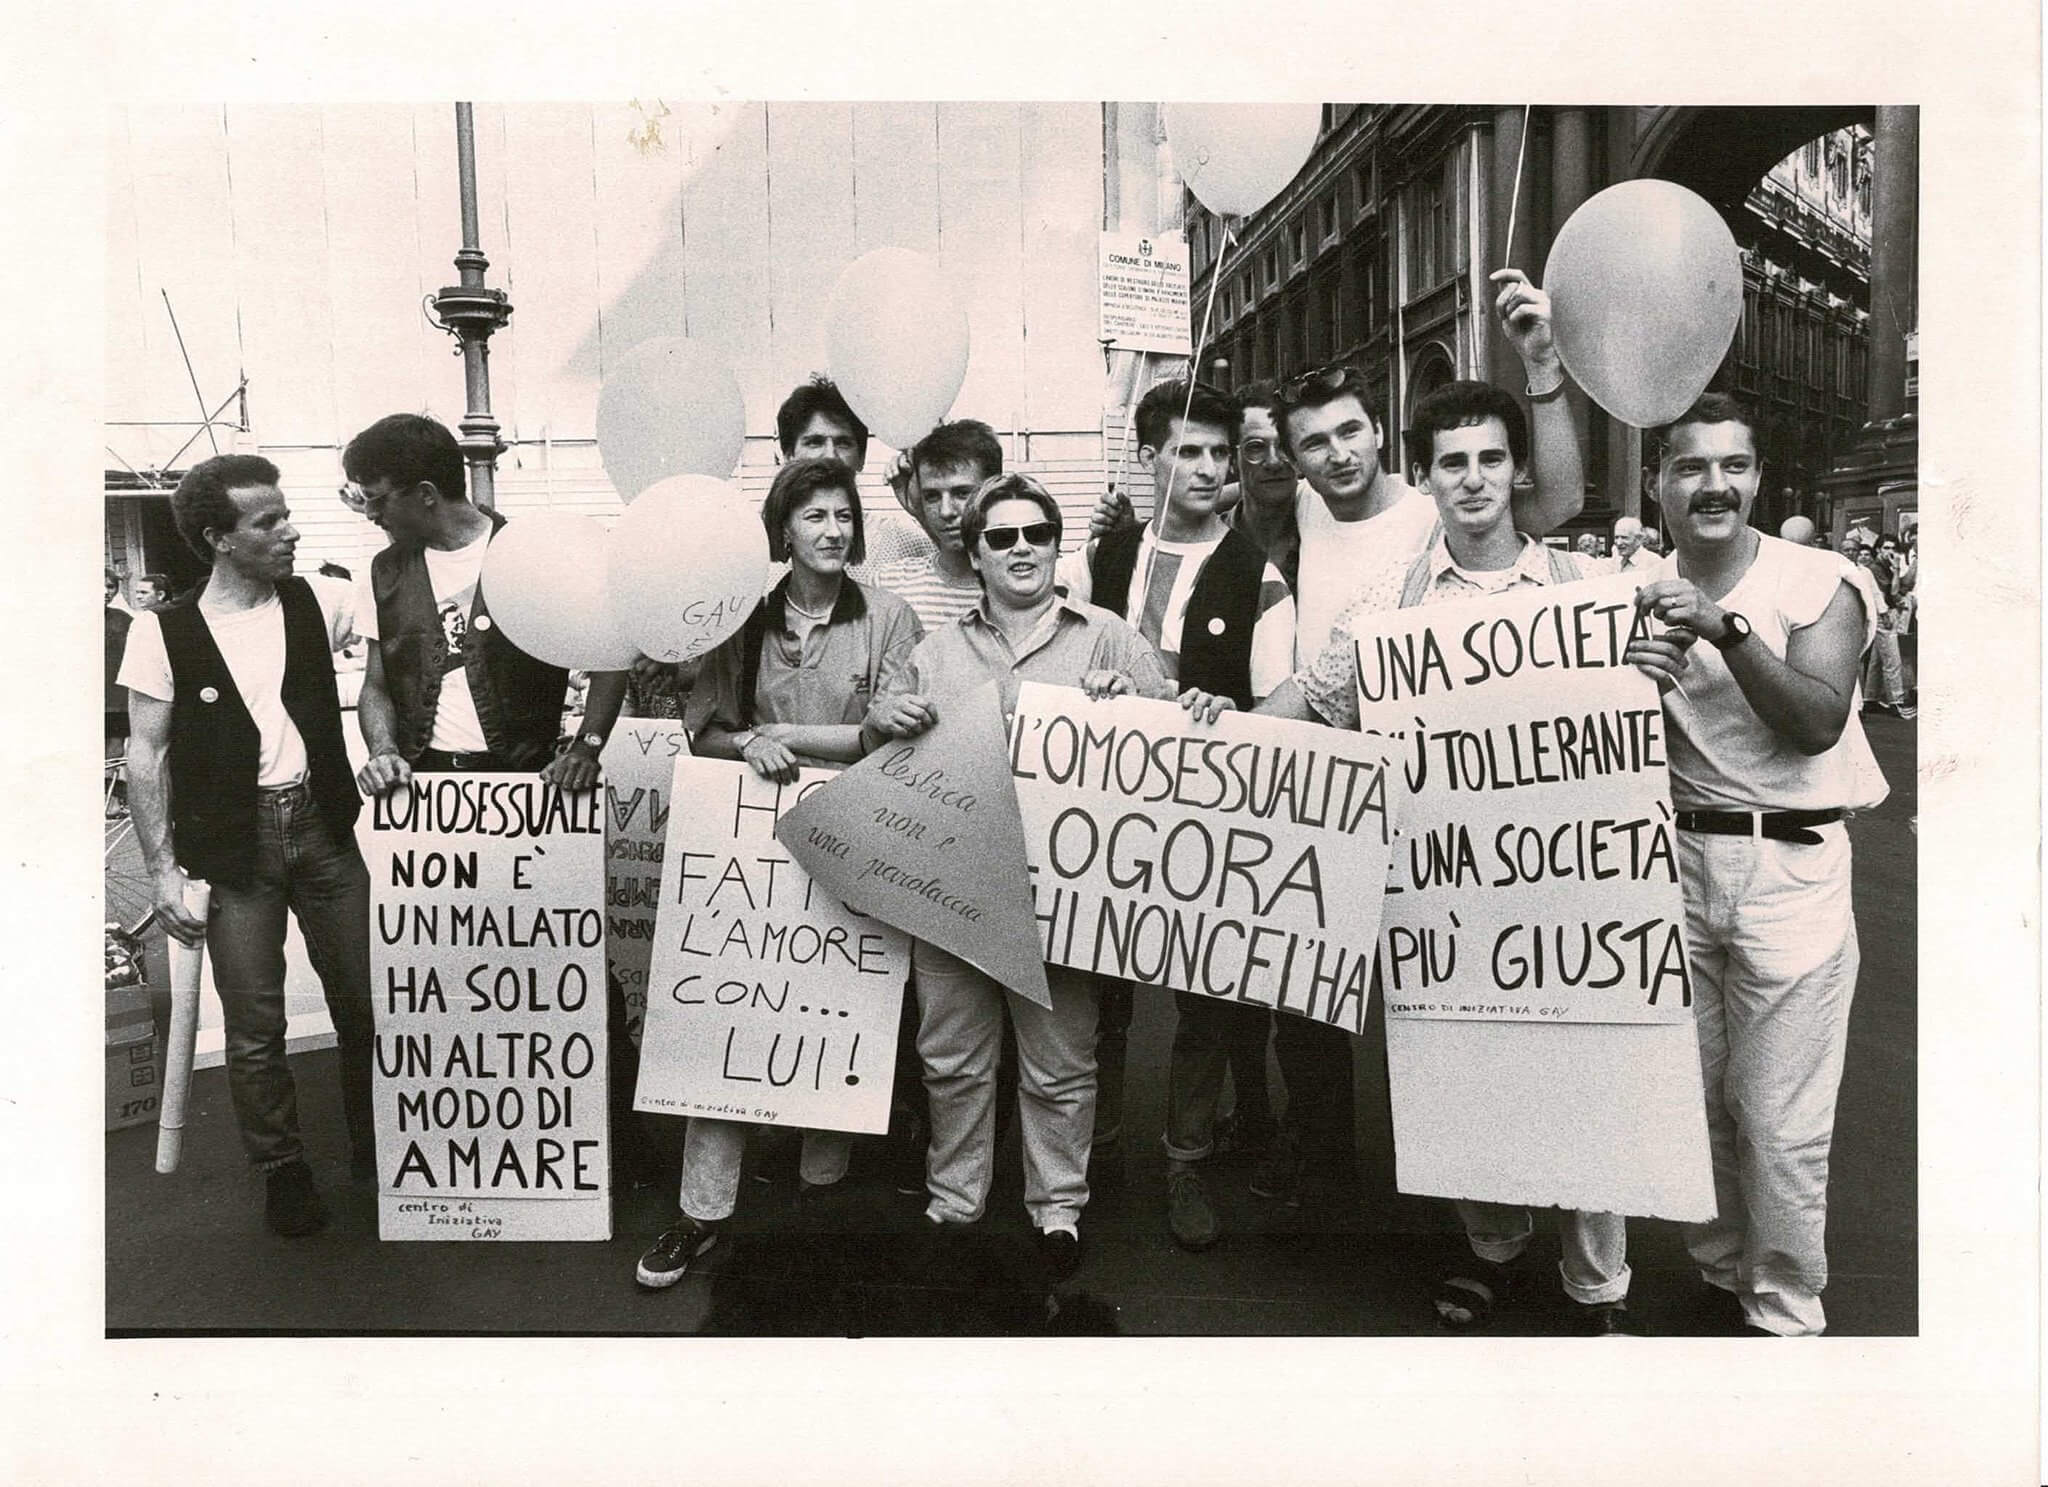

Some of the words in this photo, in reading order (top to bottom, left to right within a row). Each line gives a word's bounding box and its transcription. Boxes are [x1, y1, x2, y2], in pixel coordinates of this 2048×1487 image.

[1108, 254, 1140, 266] COMUNE
[1144, 259, 1151, 267] DI
[1355, 627, 1453, 702] UNA
[1430, 709, 1666, 791] TOLLERANTE
[880, 746, 978, 813] lesbica
[1011, 714, 1391, 845] L'OMOSESSUALITÀ
[873, 806, 928, 841] non
[1411, 822, 1482, 890] UNA
[1493, 801, 1679, 888] SOCIETÀ
[391, 850, 478, 888] NON
[807, 826, 850, 860] una
[856, 856, 985, 923] parolaccia
[1028, 807, 1327, 929] OGORA
[378, 904, 439, 945] UN
[450, 904, 602, 948] MALATO
[681, 910, 889, 975] L'AMORE
[1388, 911, 1461, 990] PIÙ
[1492, 918, 1692, 1008] GIUSTA
[388, 966, 447, 1014] HA
[465, 963, 588, 1013] SOLO
[1391, 1004, 1436, 1013] CENTRO
[1441, 1004, 1453, 1012] DI
[375, 1033, 431, 1078] UN
[444, 1032, 594, 1079] ALTRO
[723, 1026, 860, 1090] LUI!
[120, 1096, 157, 1118] 170
[398, 1087, 524, 1132] MODO
[537, 1086, 572, 1130] DI
[754, 1108, 779, 1121] GAY
[392, 1136, 599, 1191] AMARE
[398, 1201, 449, 1213] centro
[458, 1202, 473, 1213] di
[428, 1214, 502, 1226] Iniziativa
[472, 1228, 502, 1239] GAY
